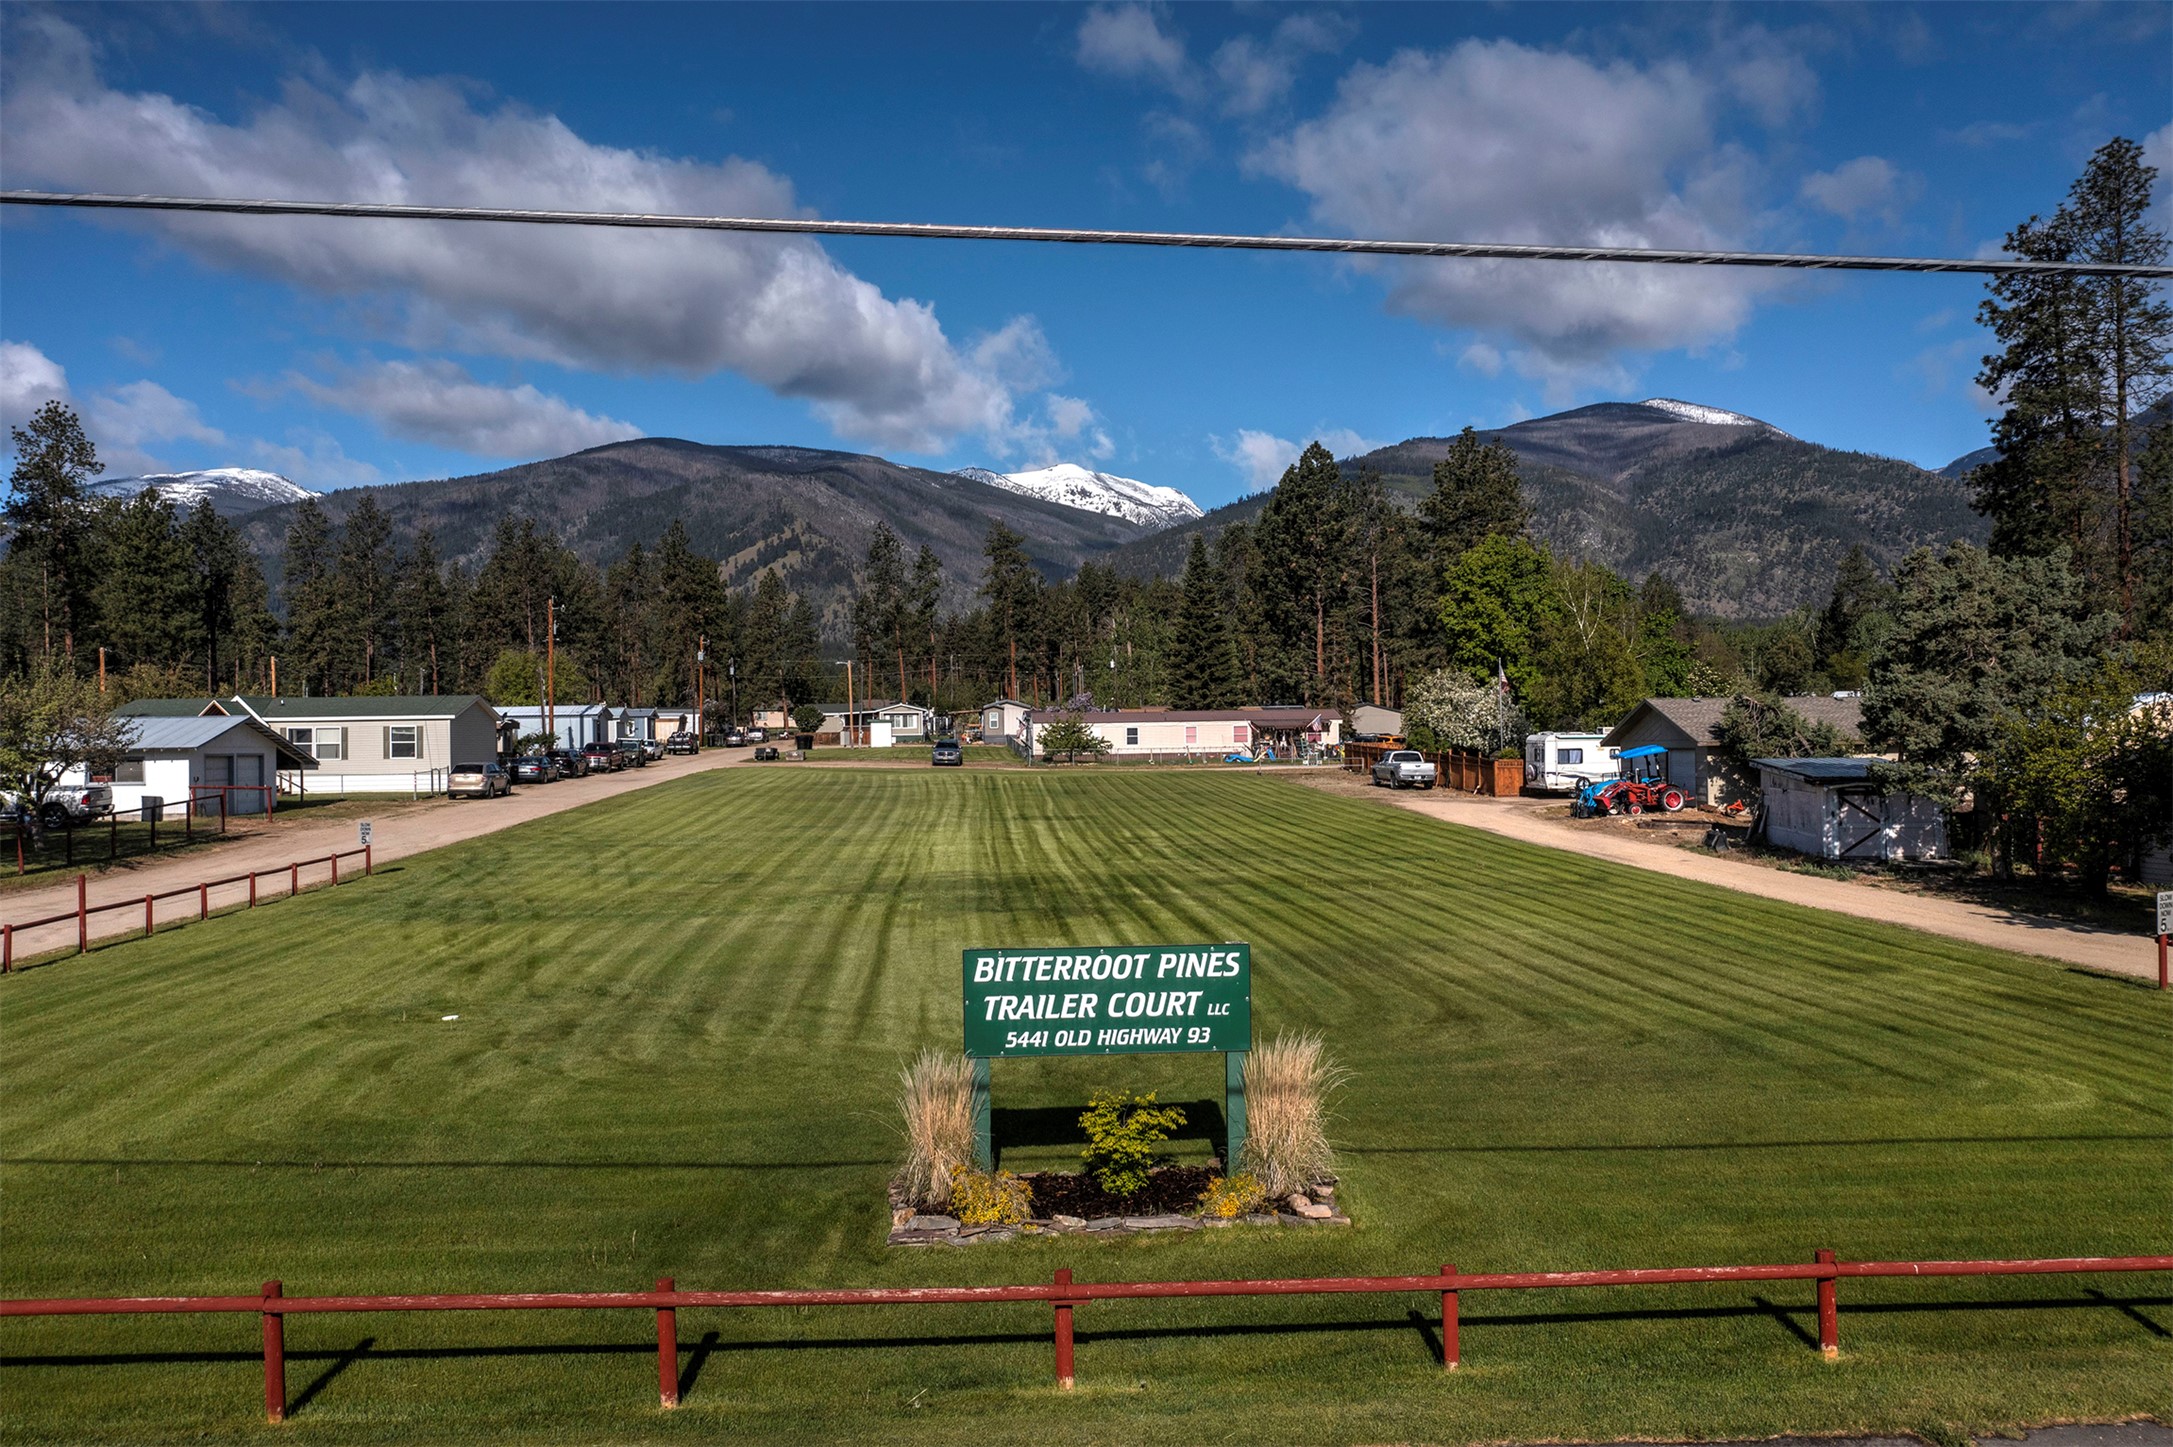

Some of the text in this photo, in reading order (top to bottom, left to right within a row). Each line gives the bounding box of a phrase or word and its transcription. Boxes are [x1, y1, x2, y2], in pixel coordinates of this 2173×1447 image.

[361, 835, 367, 844] 5
[2159, 894, 2172, 902] SLOW
[2160, 918, 2167, 932] 5
[973, 951, 1241, 983] BITTERROOT PINES
[983, 990, 1231, 1021] TRAILER COURT LLC
[1005, 1027, 1211, 1048] 5441 OLD HIGHWAY 93
